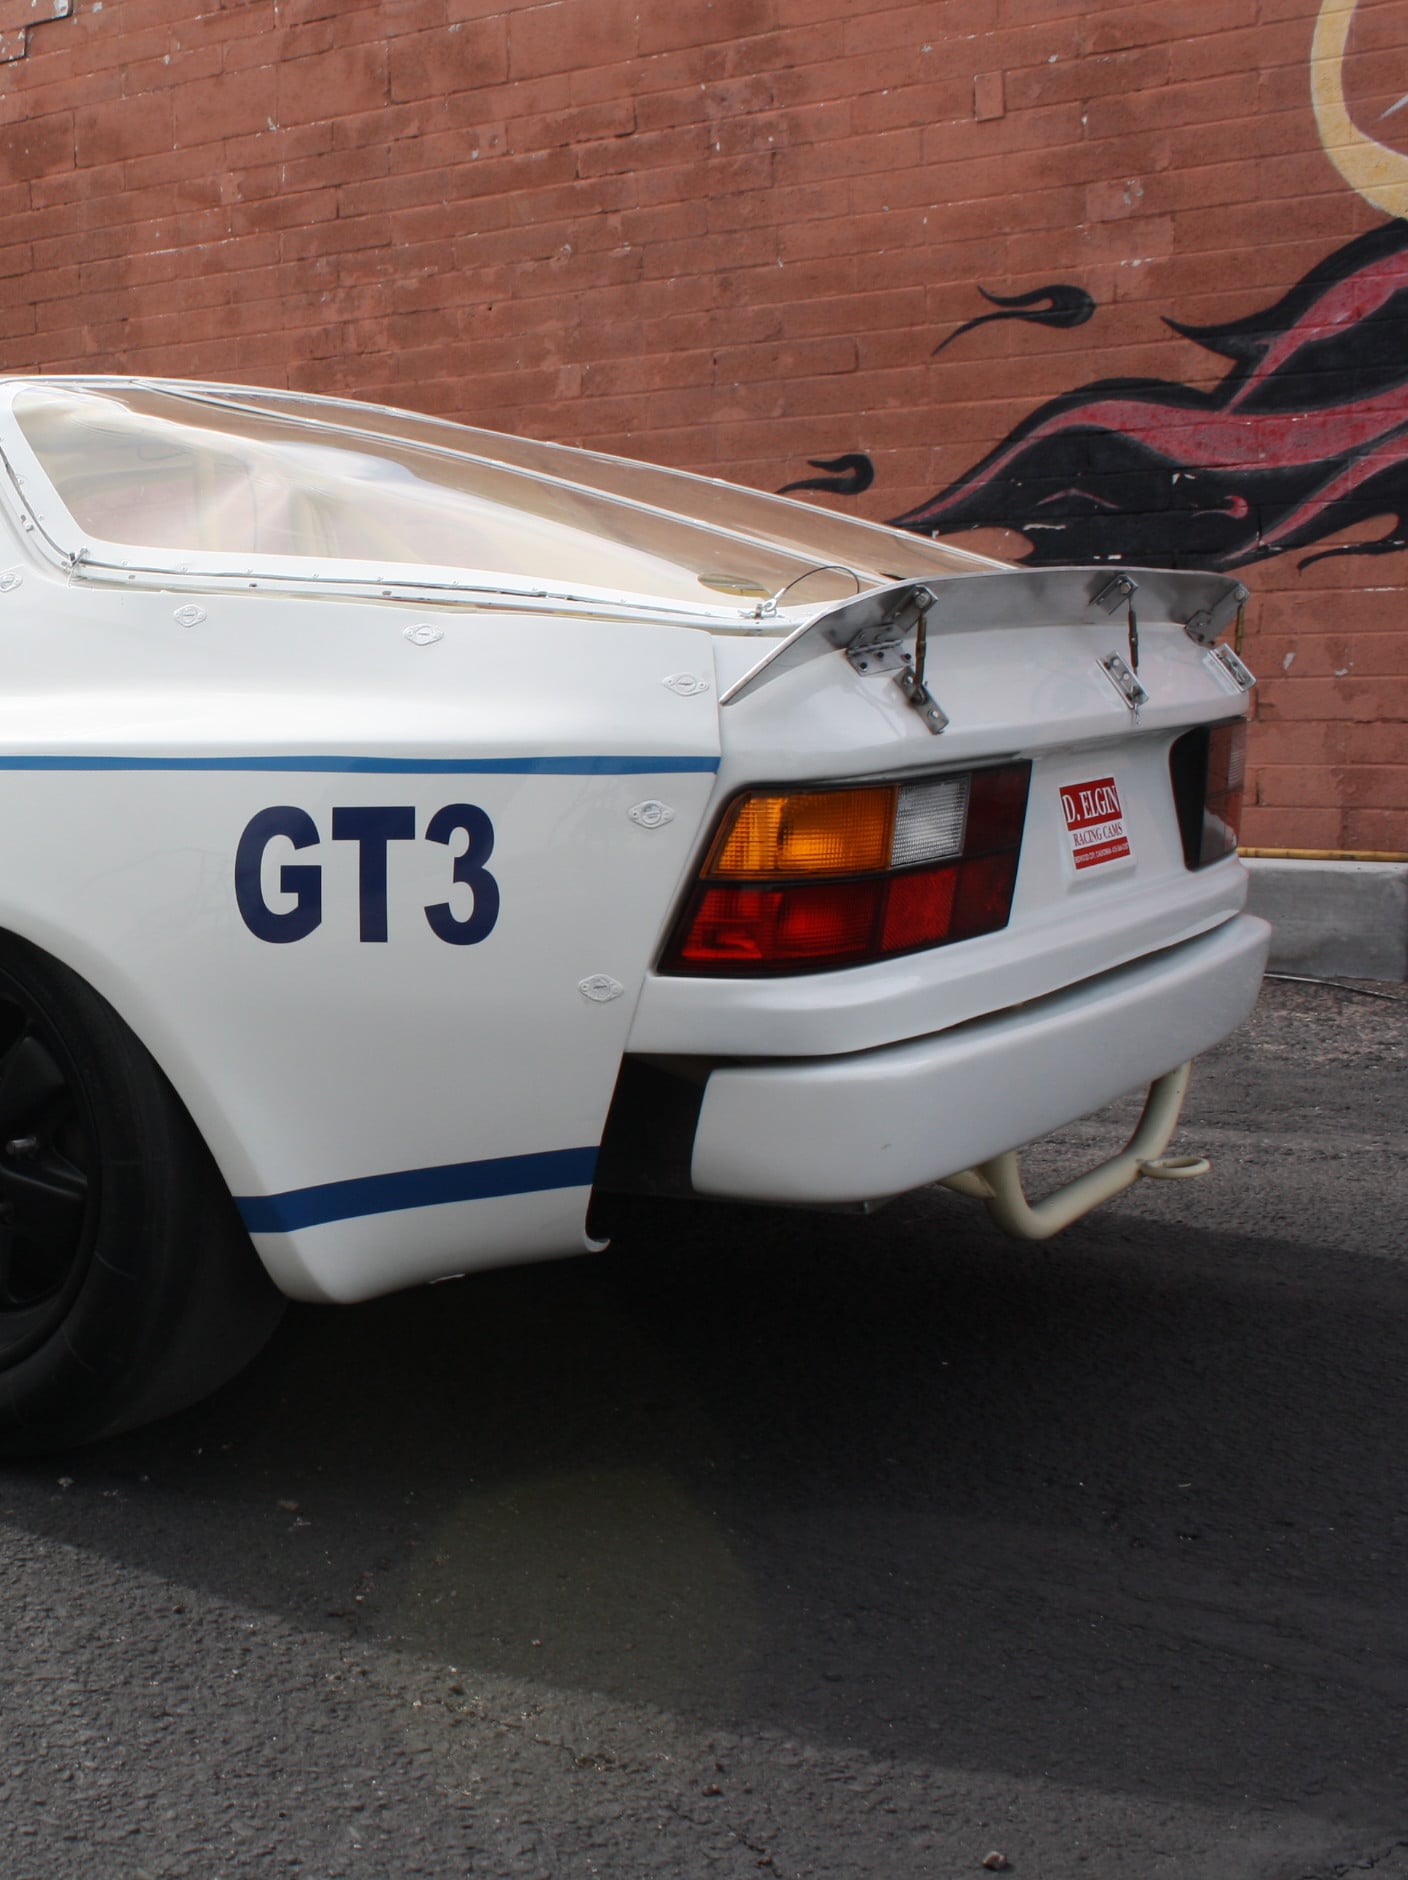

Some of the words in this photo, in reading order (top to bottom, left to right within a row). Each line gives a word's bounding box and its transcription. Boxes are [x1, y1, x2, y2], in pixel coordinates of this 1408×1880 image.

[1062, 794, 1081, 823] D.
[1079, 785, 1120, 819] ELGIN
[1073, 827, 1102, 847] RACING
[1103, 822, 1123, 839] CAMS
[235, 804, 499, 945] GT3
